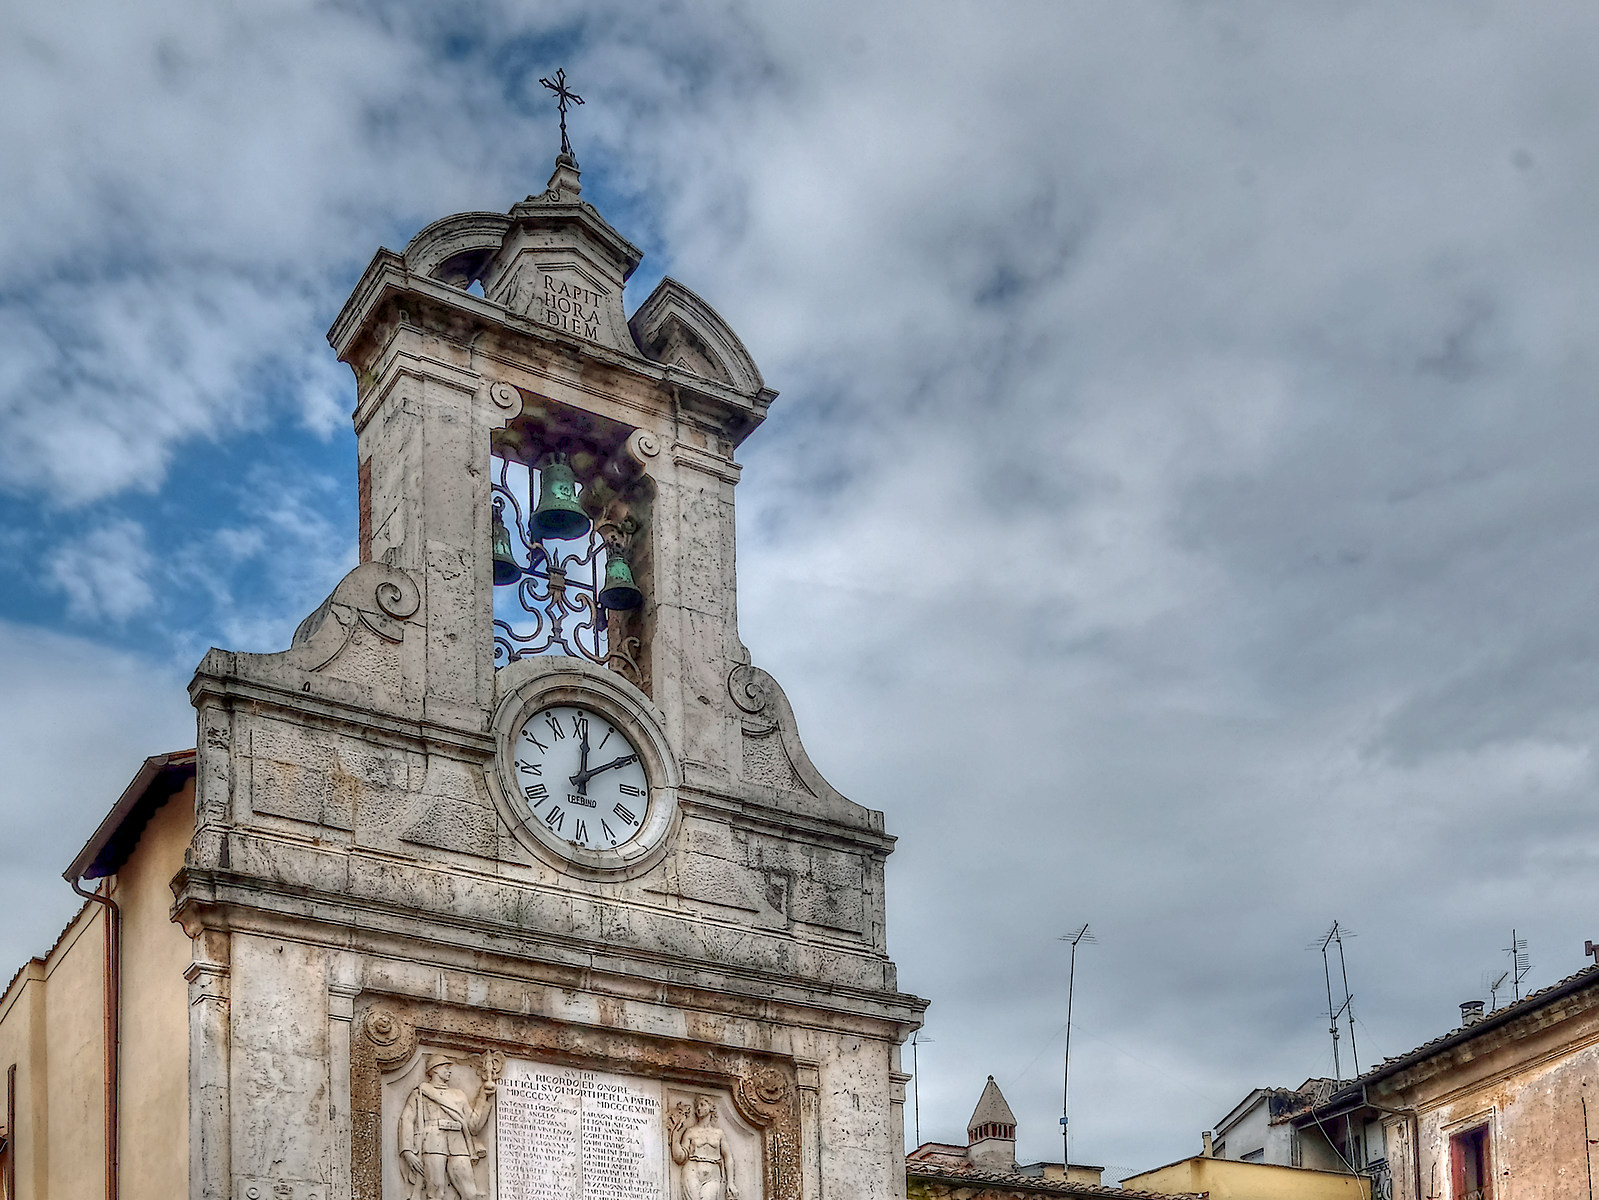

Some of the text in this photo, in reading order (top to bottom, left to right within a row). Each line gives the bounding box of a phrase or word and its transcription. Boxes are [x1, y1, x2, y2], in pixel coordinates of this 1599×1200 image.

[544, 274, 602, 308] RAPIT
[544, 292, 601, 325] HORA
[546, 309, 598, 341] DIEM
[526, 732, 548, 754] X
[601, 818, 616, 840] V
[524, 1073, 630, 1095] A RICORDO ED ONORE
[566, 1087, 595, 1099] MORTI
[597, 1092, 615, 1101] PER
[617, 1095, 629, 1103] LA
[631, 1096, 661, 1108] PATRIA
